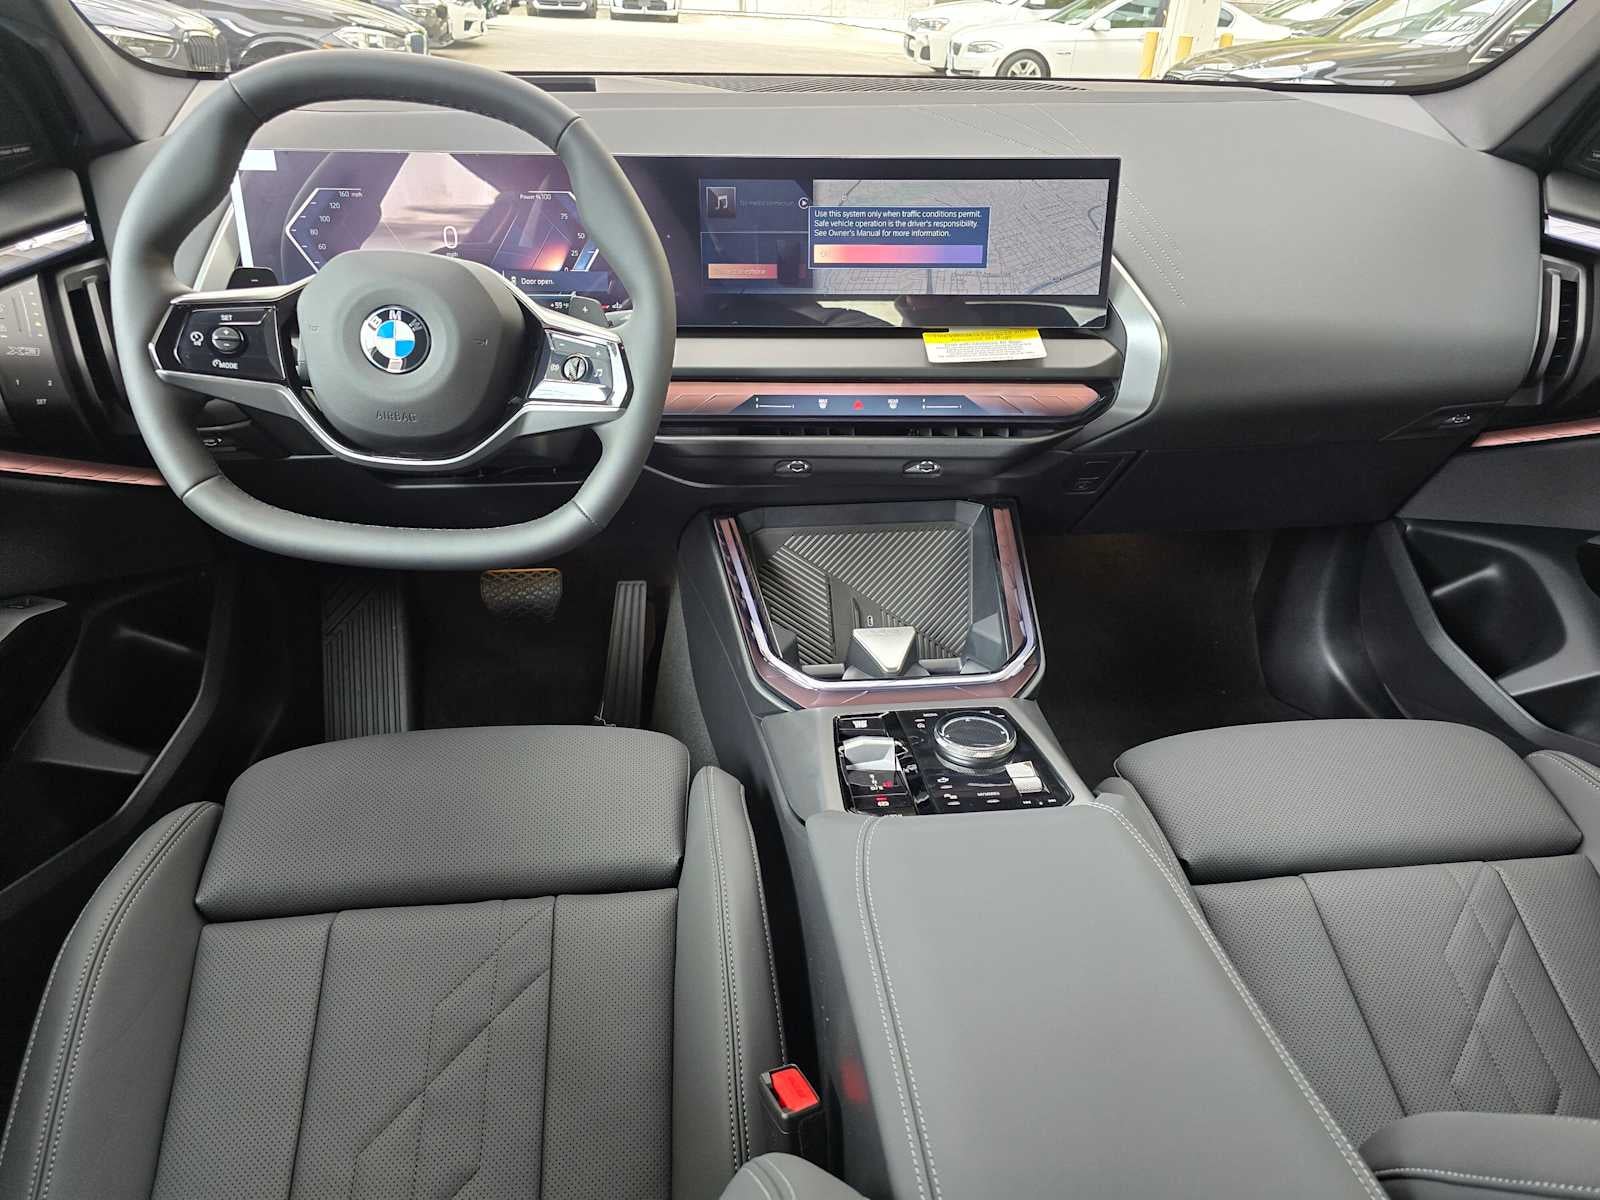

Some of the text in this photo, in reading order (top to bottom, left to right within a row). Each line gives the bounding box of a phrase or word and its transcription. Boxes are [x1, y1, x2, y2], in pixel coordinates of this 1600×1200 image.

[814, 210, 982, 219] Use this system only when traffic conditions permit.
[814, 219, 829, 227] Safe
[831, 219, 854, 227] vehicle
[855, 220, 887, 229] operation
[895, 219, 907, 227] the
[907, 219, 933, 227] driver's
[444, 226, 457, 249] 0
[814, 229, 828, 237] See
[828, 229, 855, 237] Owner's
[856, 229, 881, 237] Manual
[881, 229, 892, 237] for
[911, 229, 951, 237] information.
[219, 361, 239, 370] MODE
[375, 409, 417, 422] AIRBAG
